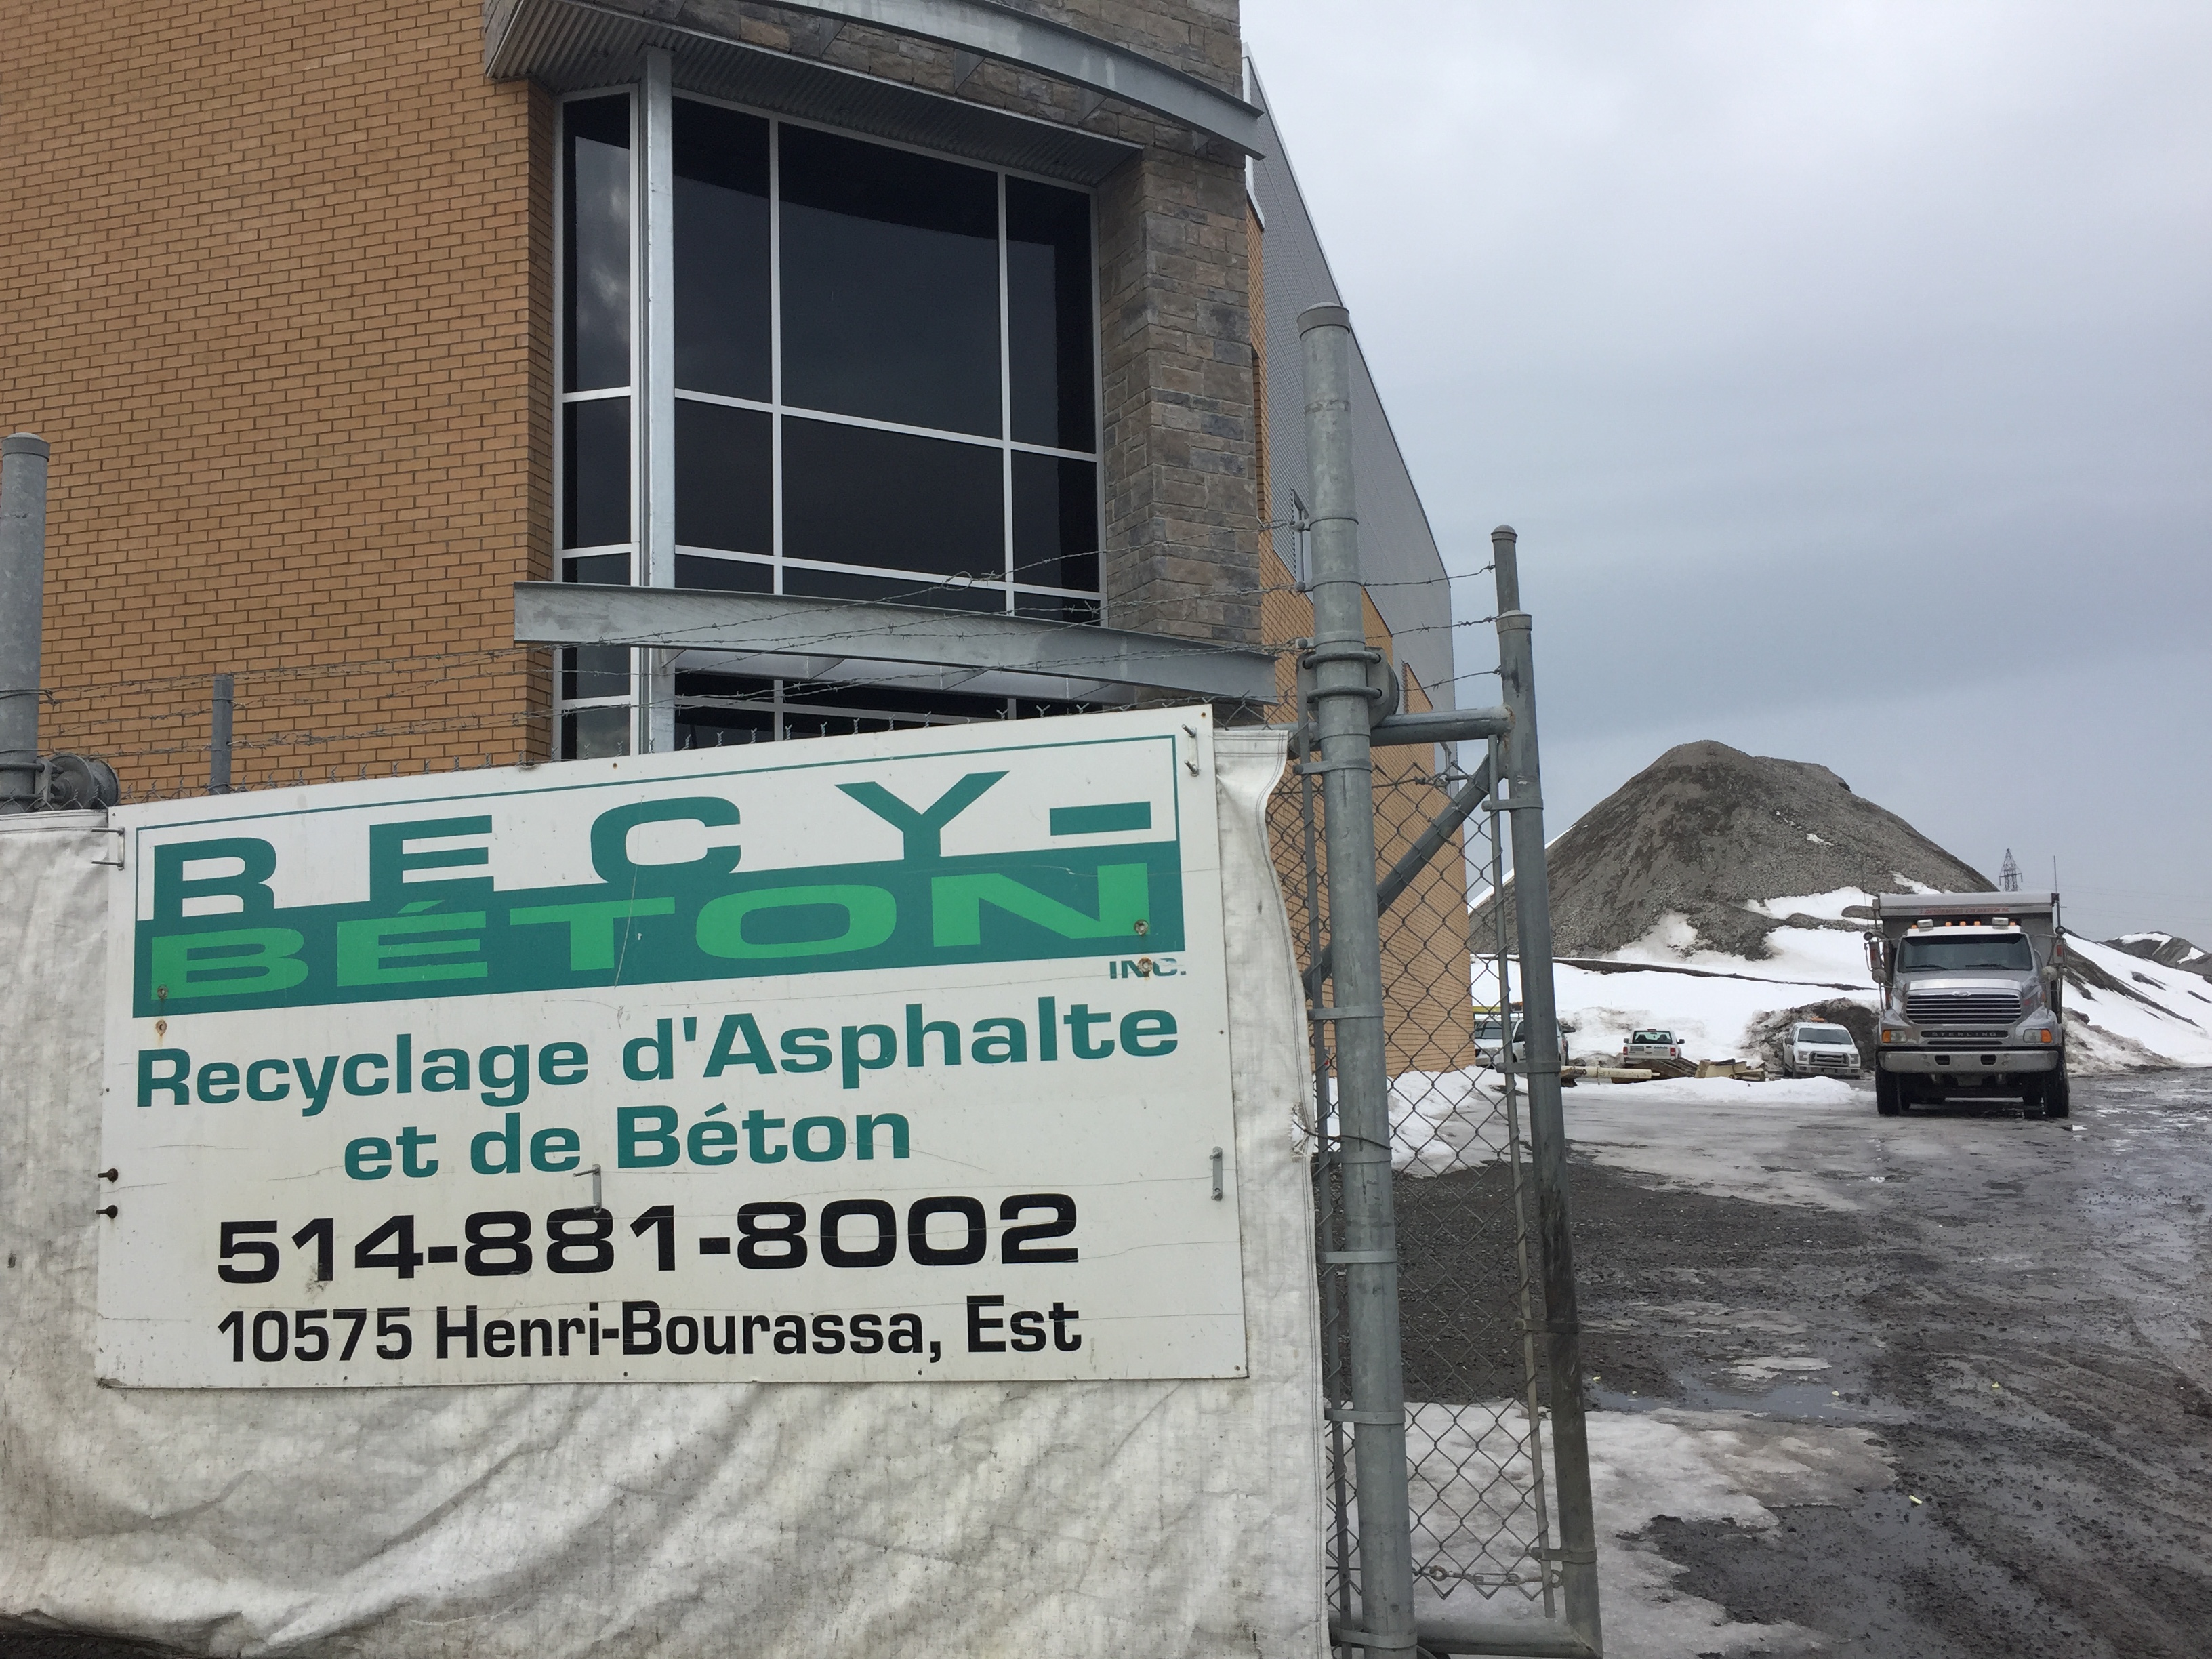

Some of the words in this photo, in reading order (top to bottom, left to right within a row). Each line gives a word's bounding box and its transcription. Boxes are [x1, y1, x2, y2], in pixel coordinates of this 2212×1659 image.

[153, 771, 1151, 921] RECY-
[151, 863, 1150, 1000] BÉTON
[1109, 958, 1186, 979] INC.
[137, 1034, 588, 1117] Recyclage
[623, 997, 1178, 1090] d'Asphalte
[344, 1126, 438, 1181] et
[470, 1112, 581, 1175] de
[617, 1102, 910, 1168] Béton
[218, 1193, 1079, 1284] 514-881-8002
[218, 1307, 412, 1363] 10575
[436, 1300, 941, 1364] Henri-Bourassa,
[966, 1294, 1082, 1353] Est
